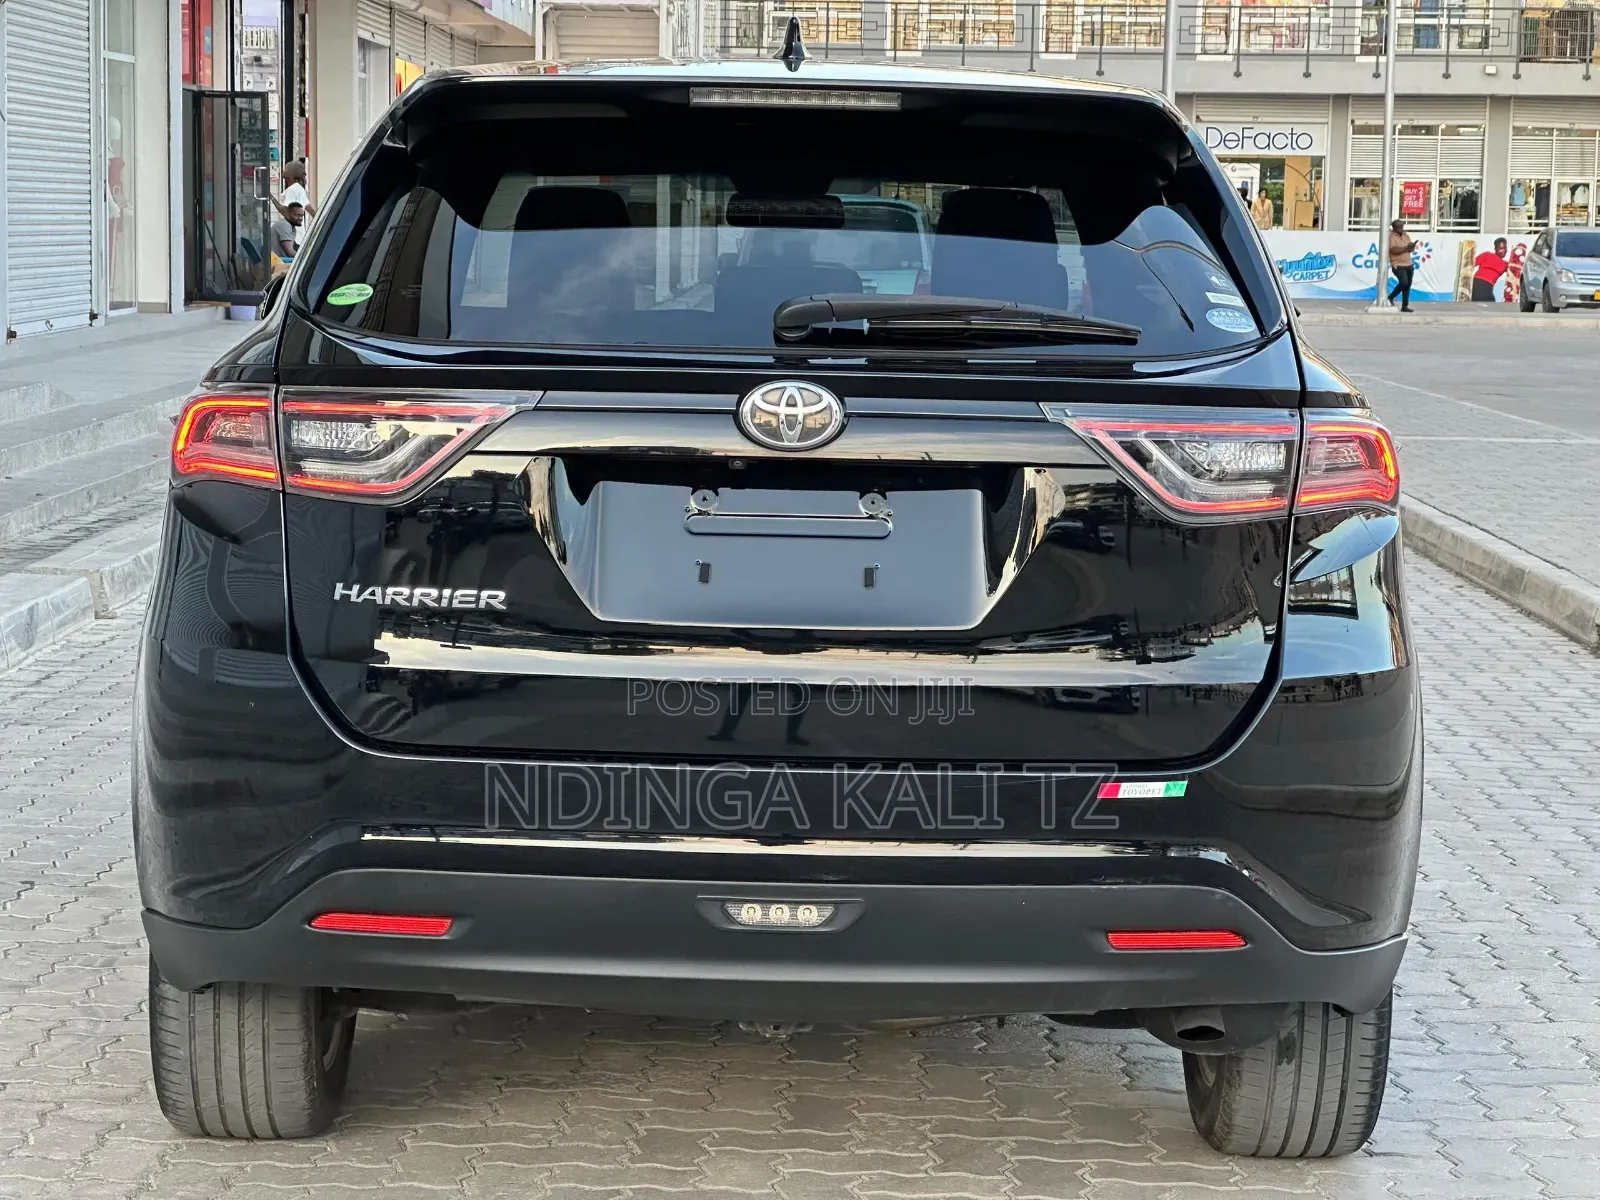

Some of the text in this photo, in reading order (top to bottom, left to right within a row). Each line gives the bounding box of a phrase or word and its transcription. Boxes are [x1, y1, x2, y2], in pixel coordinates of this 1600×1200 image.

[1205, 126, 1314, 150] DeFacto
[1292, 270, 1331, 281] CARPET
[333, 582, 507, 610] HARRIER
[1122, 788, 1162, 796] TOYOPET
